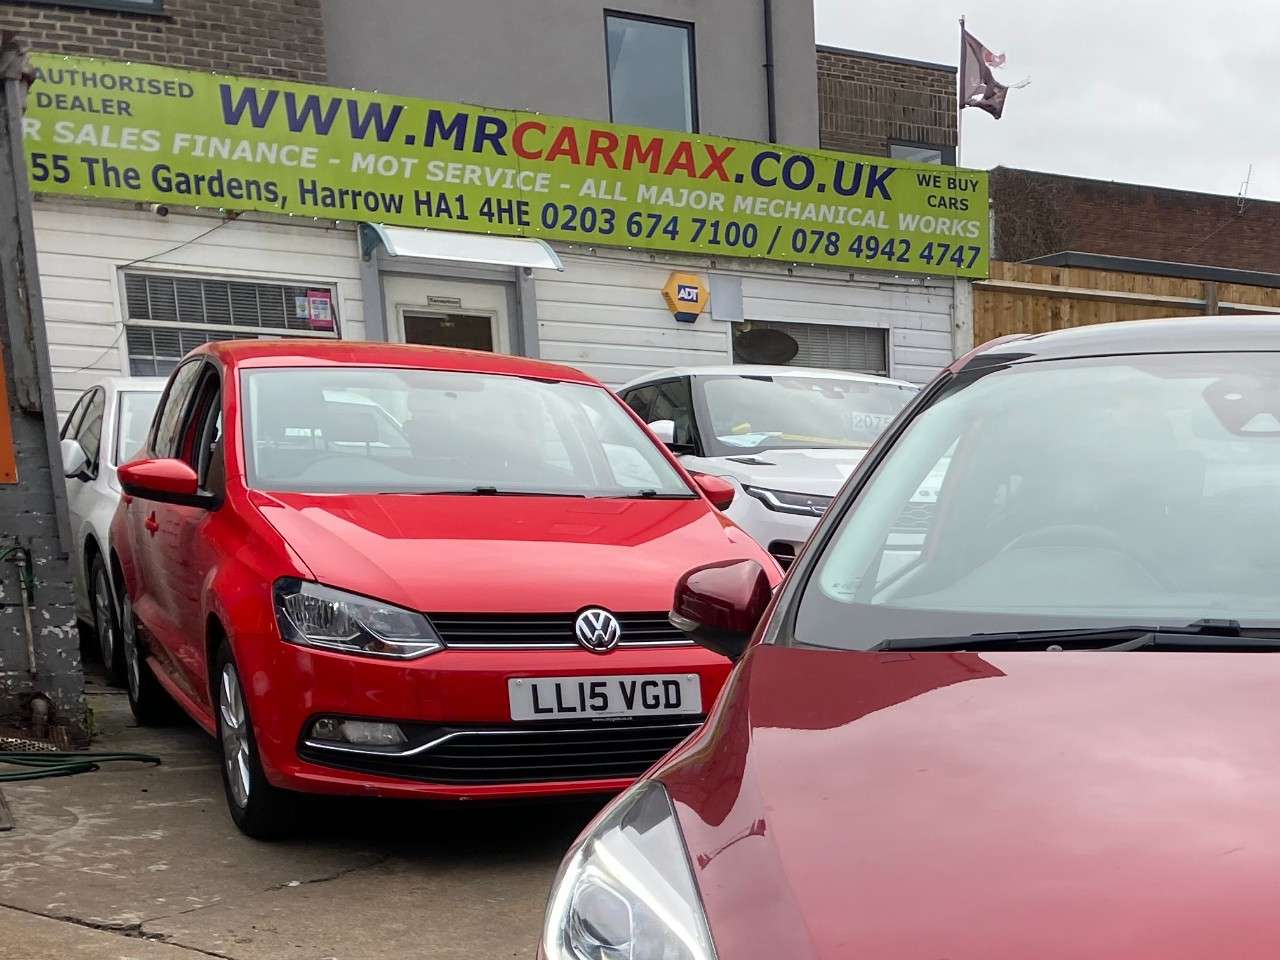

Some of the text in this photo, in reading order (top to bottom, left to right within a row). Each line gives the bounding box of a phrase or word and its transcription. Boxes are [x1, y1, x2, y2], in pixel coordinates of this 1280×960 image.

[33, 67, 194, 98] AUTHORISED
[37, 92, 133, 117] DEALER
[219, 84, 897, 200] WWW.MRCARMAX.CO.UK
[53, 121, 161, 152] SALES
[171, 133, 319, 169] FINANCE
[351, 151, 418, 179] MOT
[426, 160, 552, 193] SERVICE
[578, 178, 628, 202] ALL
[636, 184, 725, 212] MAJOR
[733, 194, 889, 229] MECHANICAL
[898, 213, 980, 238] WORKS
[916, 173, 979, 193] WE BUY
[31, 152, 71, 184] 55
[80, 156, 141, 190] The
[151, 162, 288, 210] Gardens,
[298, 178, 404, 214] Harrow
[414, 190, 469, 221] HA1
[479, 197, 531, 227] 4HE
[541, 202, 616, 235] 0203
[626, 210, 679, 241] 674
[690, 217, 758, 249] 7100
[791, 228, 841, 256] 078
[848, 234, 911, 263] 4942
[919, 241, 982, 269] 4747
[927, 194, 969, 211] CARS
[678, 287, 698, 301] ADT
[531, 680, 682, 714] LL15 VGD
